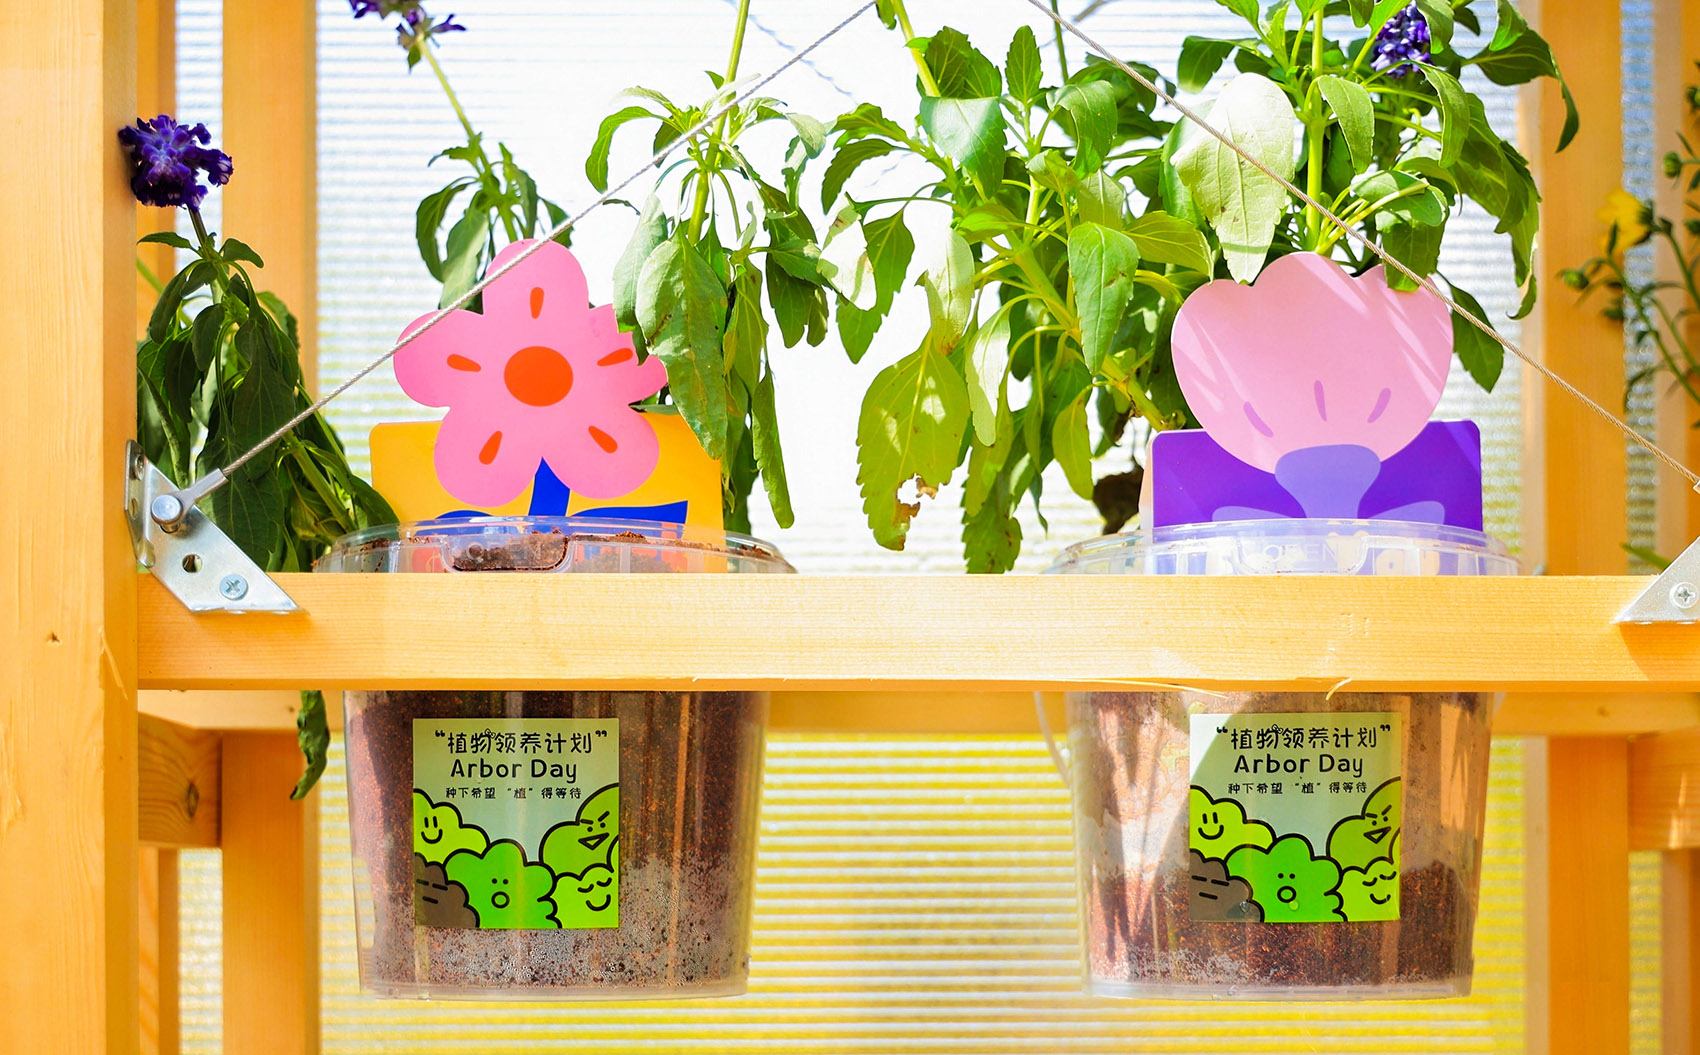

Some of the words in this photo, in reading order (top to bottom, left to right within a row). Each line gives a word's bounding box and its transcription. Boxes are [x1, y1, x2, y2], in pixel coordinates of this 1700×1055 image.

[450, 758, 522, 779] Arbor
[531, 759, 577, 784] Day
[1234, 753, 1310, 774] Arbor
[1319, 754, 1364, 778] Day
[445, 787, 496, 800] 种下希望
[540, 787, 583, 800] 得等待
[1227, 782, 1284, 795] 种下希望
[1328, 781, 1368, 794] 得等待
